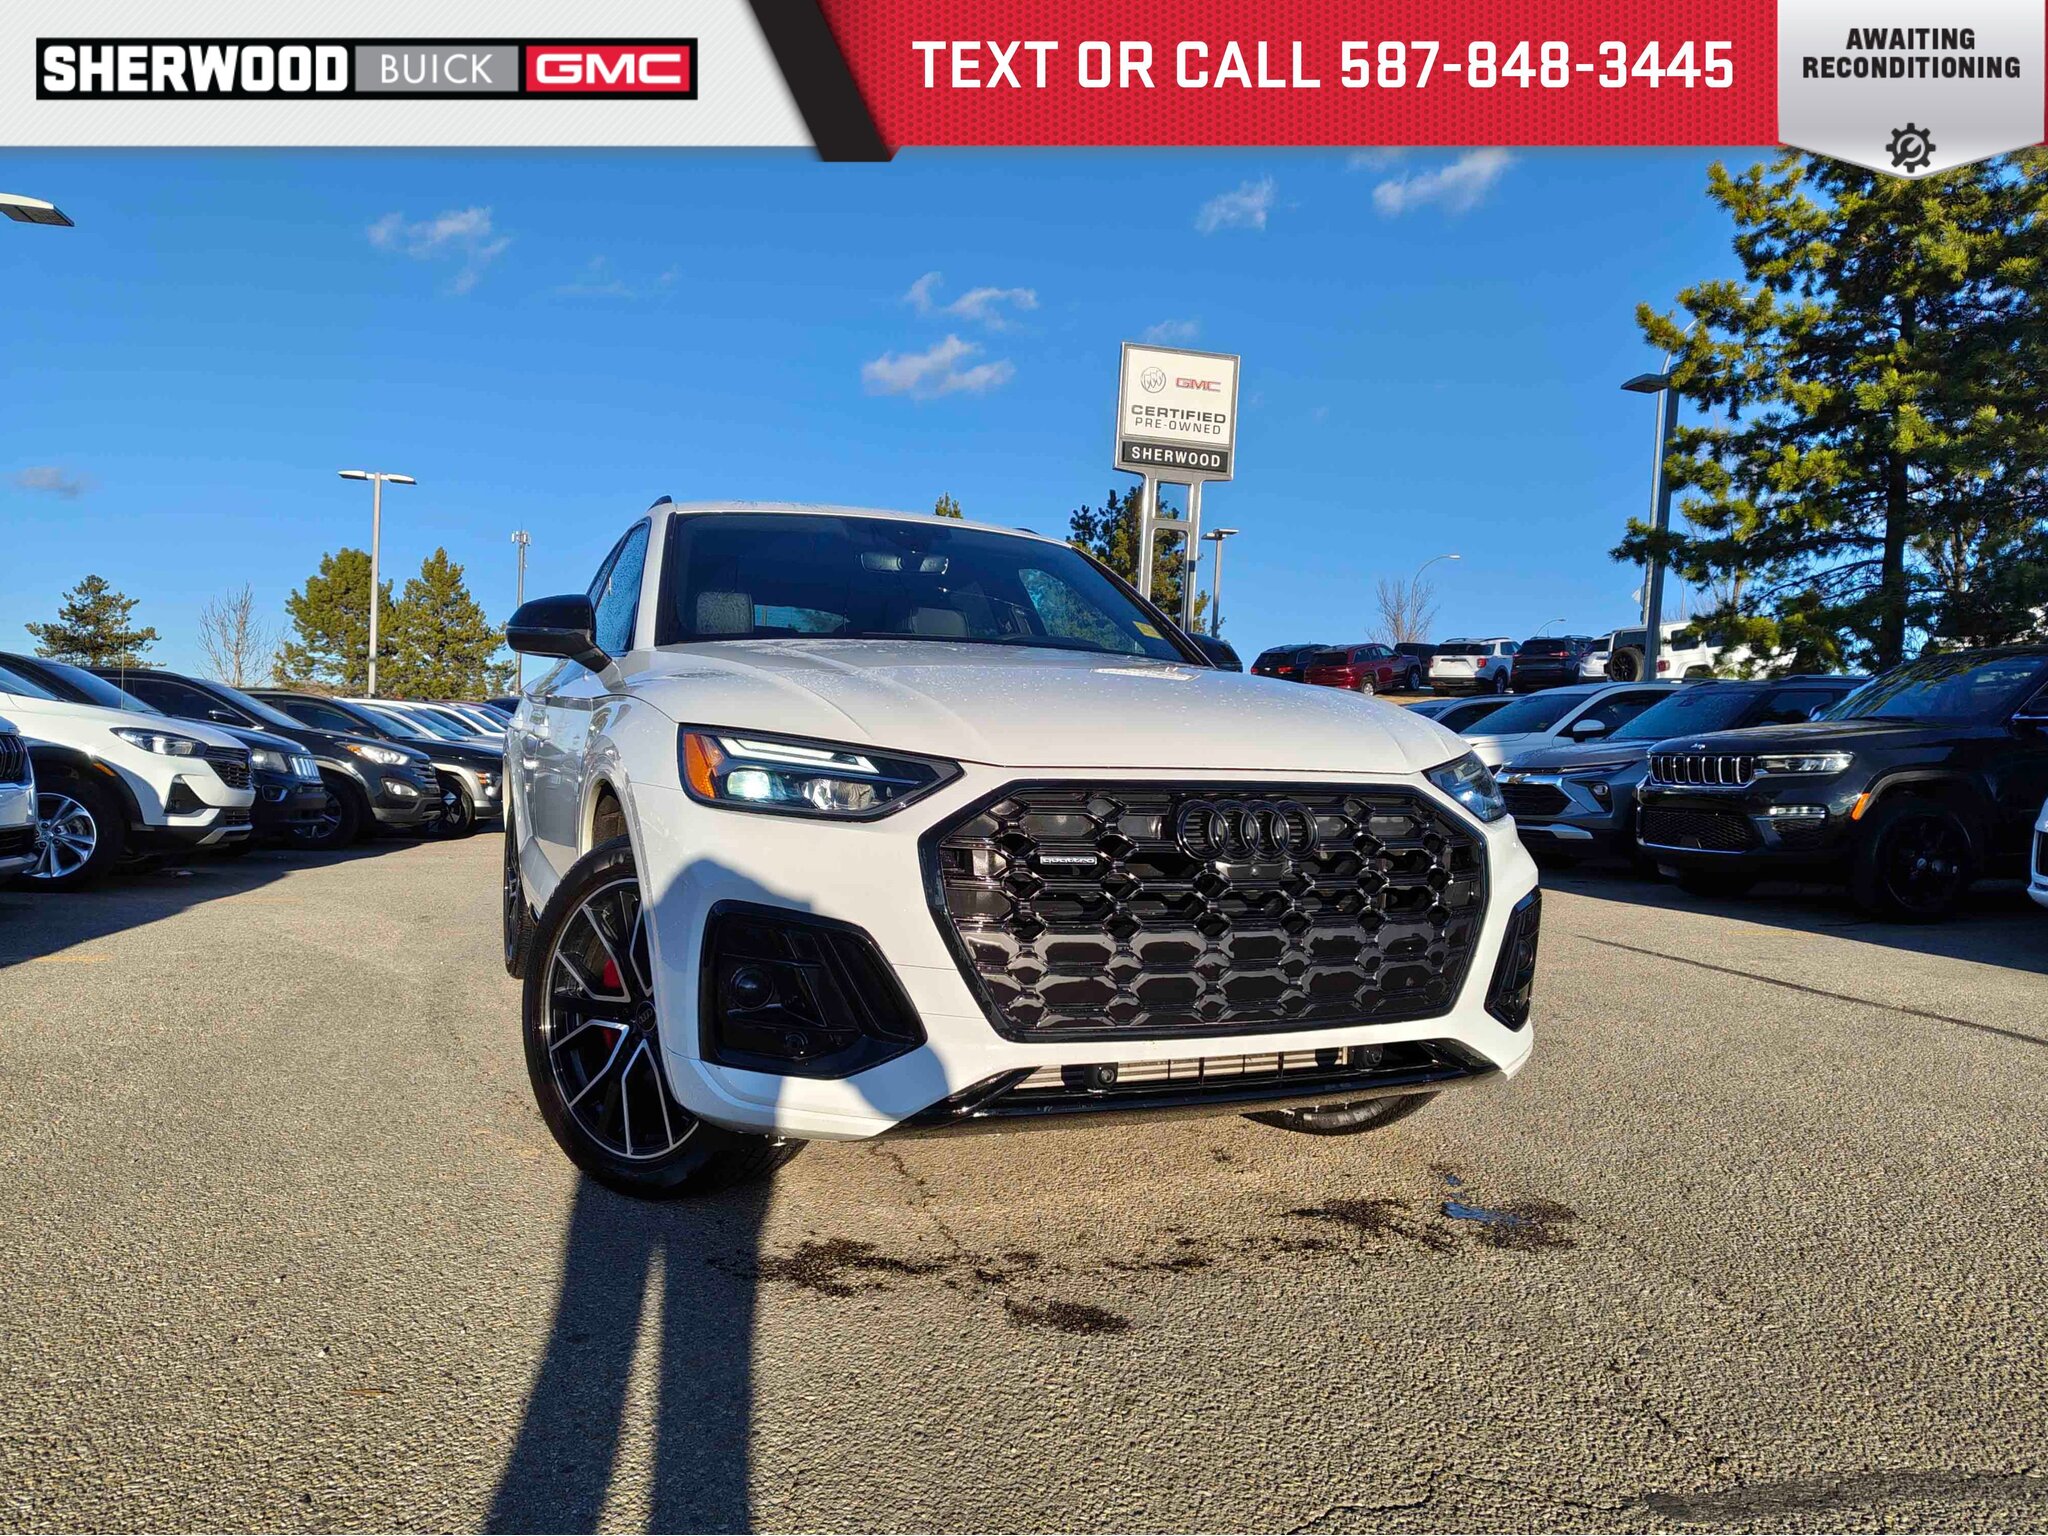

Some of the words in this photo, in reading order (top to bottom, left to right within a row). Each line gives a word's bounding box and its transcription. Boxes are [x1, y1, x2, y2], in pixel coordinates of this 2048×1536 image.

[1175, 377, 1222, 392] GMC
[1131, 404, 1226, 424] CERTIFIED
[1135, 417, 1221, 435] PRE-OWNED
[1131, 446, 1221, 467] SHERWOOD
